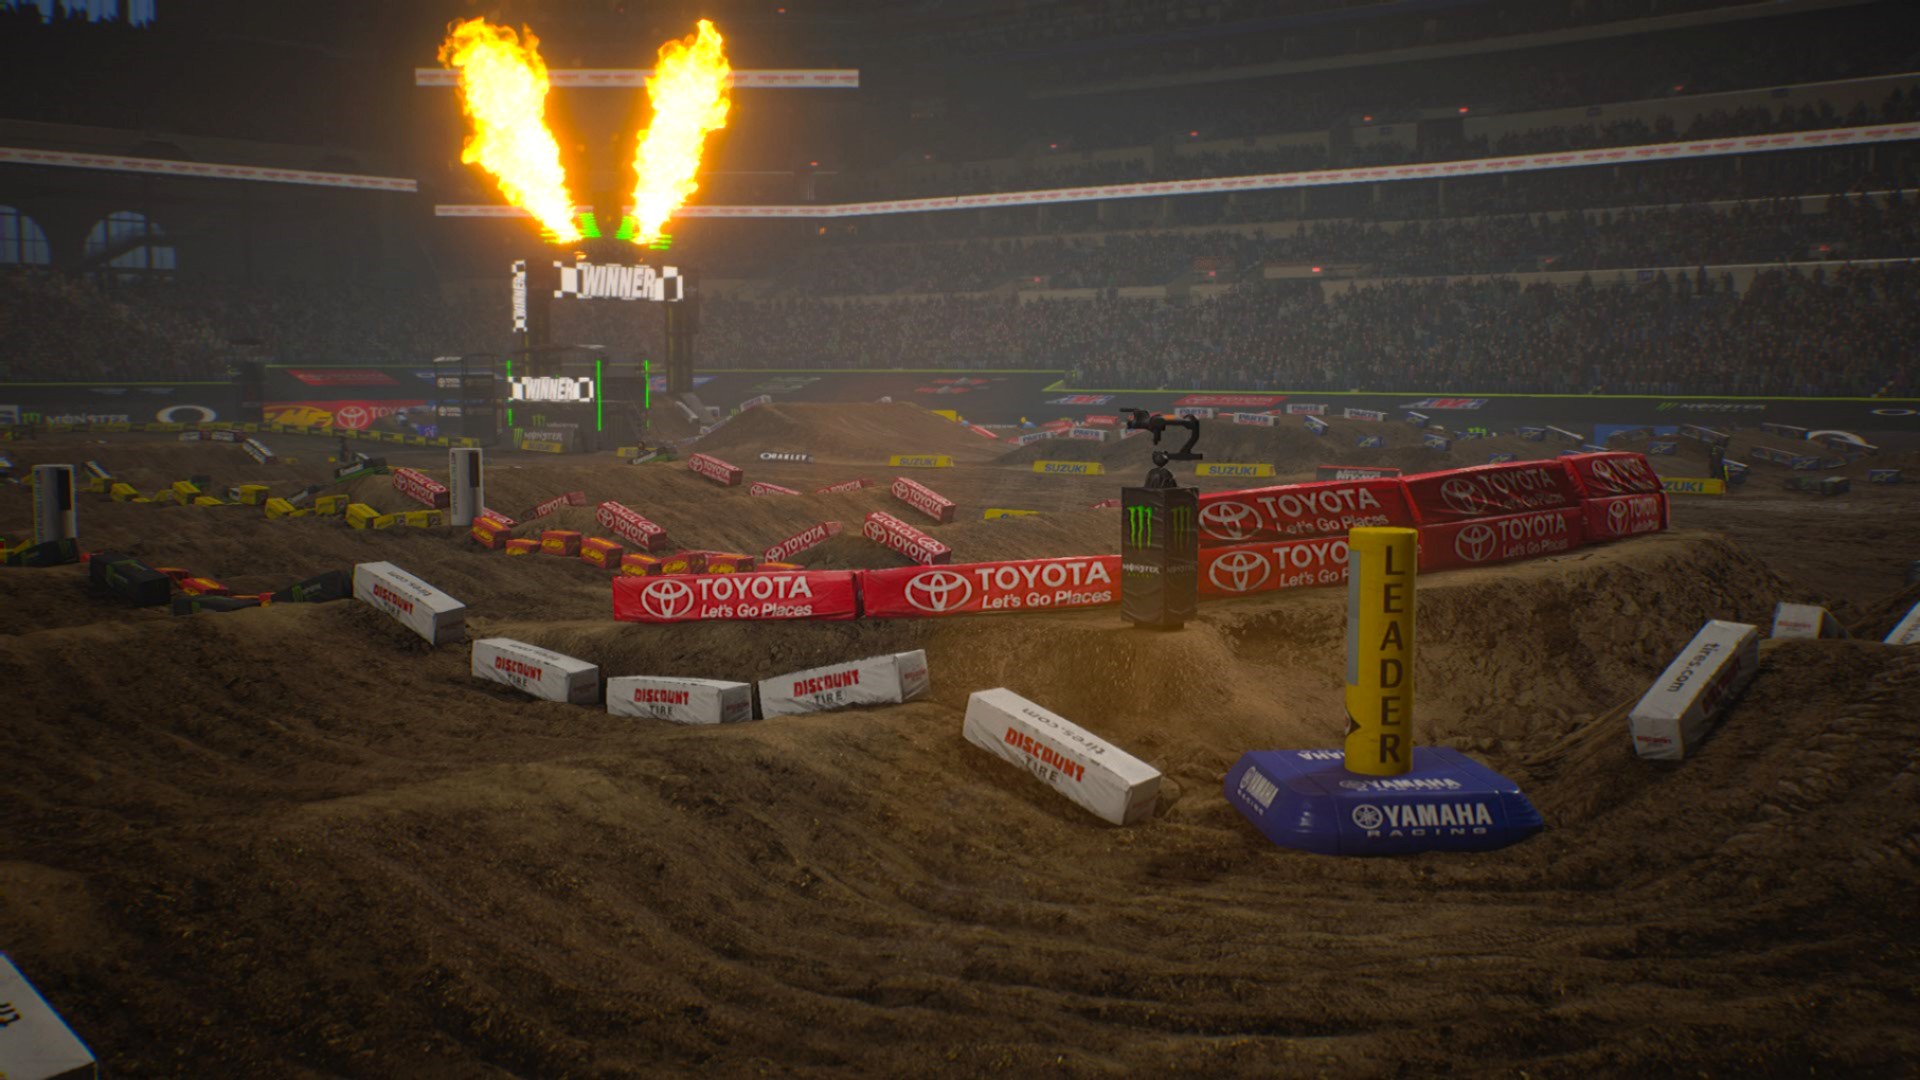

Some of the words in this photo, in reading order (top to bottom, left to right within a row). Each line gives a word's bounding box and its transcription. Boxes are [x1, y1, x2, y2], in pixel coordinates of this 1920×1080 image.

[580, 264, 657, 299] WINNER
[525, 377, 576, 401] WINNER
[703, 460, 731, 479] TOYOTA
[1045, 463, 1088, 473] SUZUKI
[1209, 465, 1257, 476] SUZUKI
[1476, 468, 1557, 496] TOYOTA
[1663, 481, 1704, 492] ZUKI
[537, 496, 568, 518] TOYOTA
[908, 489, 942, 515] TOYOTA
[1258, 487, 1381, 519] TOYOTA
[614, 515, 649, 546] TOYOTA
[1317, 517, 1341, 530] Go
[1498, 512, 1568, 541] TOYOTA
[783, 524, 827, 554] TOYOTA
[888, 531, 933, 566] TOYOTA
[1273, 540, 1348, 569] TOYO
[696, 575, 813, 600] TOYOTA
[974, 561, 1112, 592] TOYOTA
[1280, 572, 1315, 588] Let's
[1317, 568, 1340, 584] Go
[373, 583, 414, 616] DISCOUNT
[701, 603, 734, 619] Let's
[736, 602, 759, 618] Go
[761, 599, 813, 618] Places
[981, 592, 1021, 610] Let's
[1025, 589, 1052, 607] Go
[1053, 586, 1112, 606] Places
[1379, 545, 1405, 764] LEADER
[495, 656, 542, 682] DISCOUNT
[1668, 643, 1719, 693] tires.com
[634, 687, 690, 706] DISCOUNT
[793, 669, 860, 698] DISCOUNT
[649, 704, 674, 716] TIRE
[813, 690, 846, 706] TIRE
[1022, 707, 1106, 756] tires.com
[1004, 727, 1085, 782] DISCOUNT
[1022, 753, 1060, 781] TIRE
[1367, 778, 1462, 790] YAMAHA
[1382, 802, 1493, 828] YAMAHA
[1366, 827, 1488, 838] RACING
